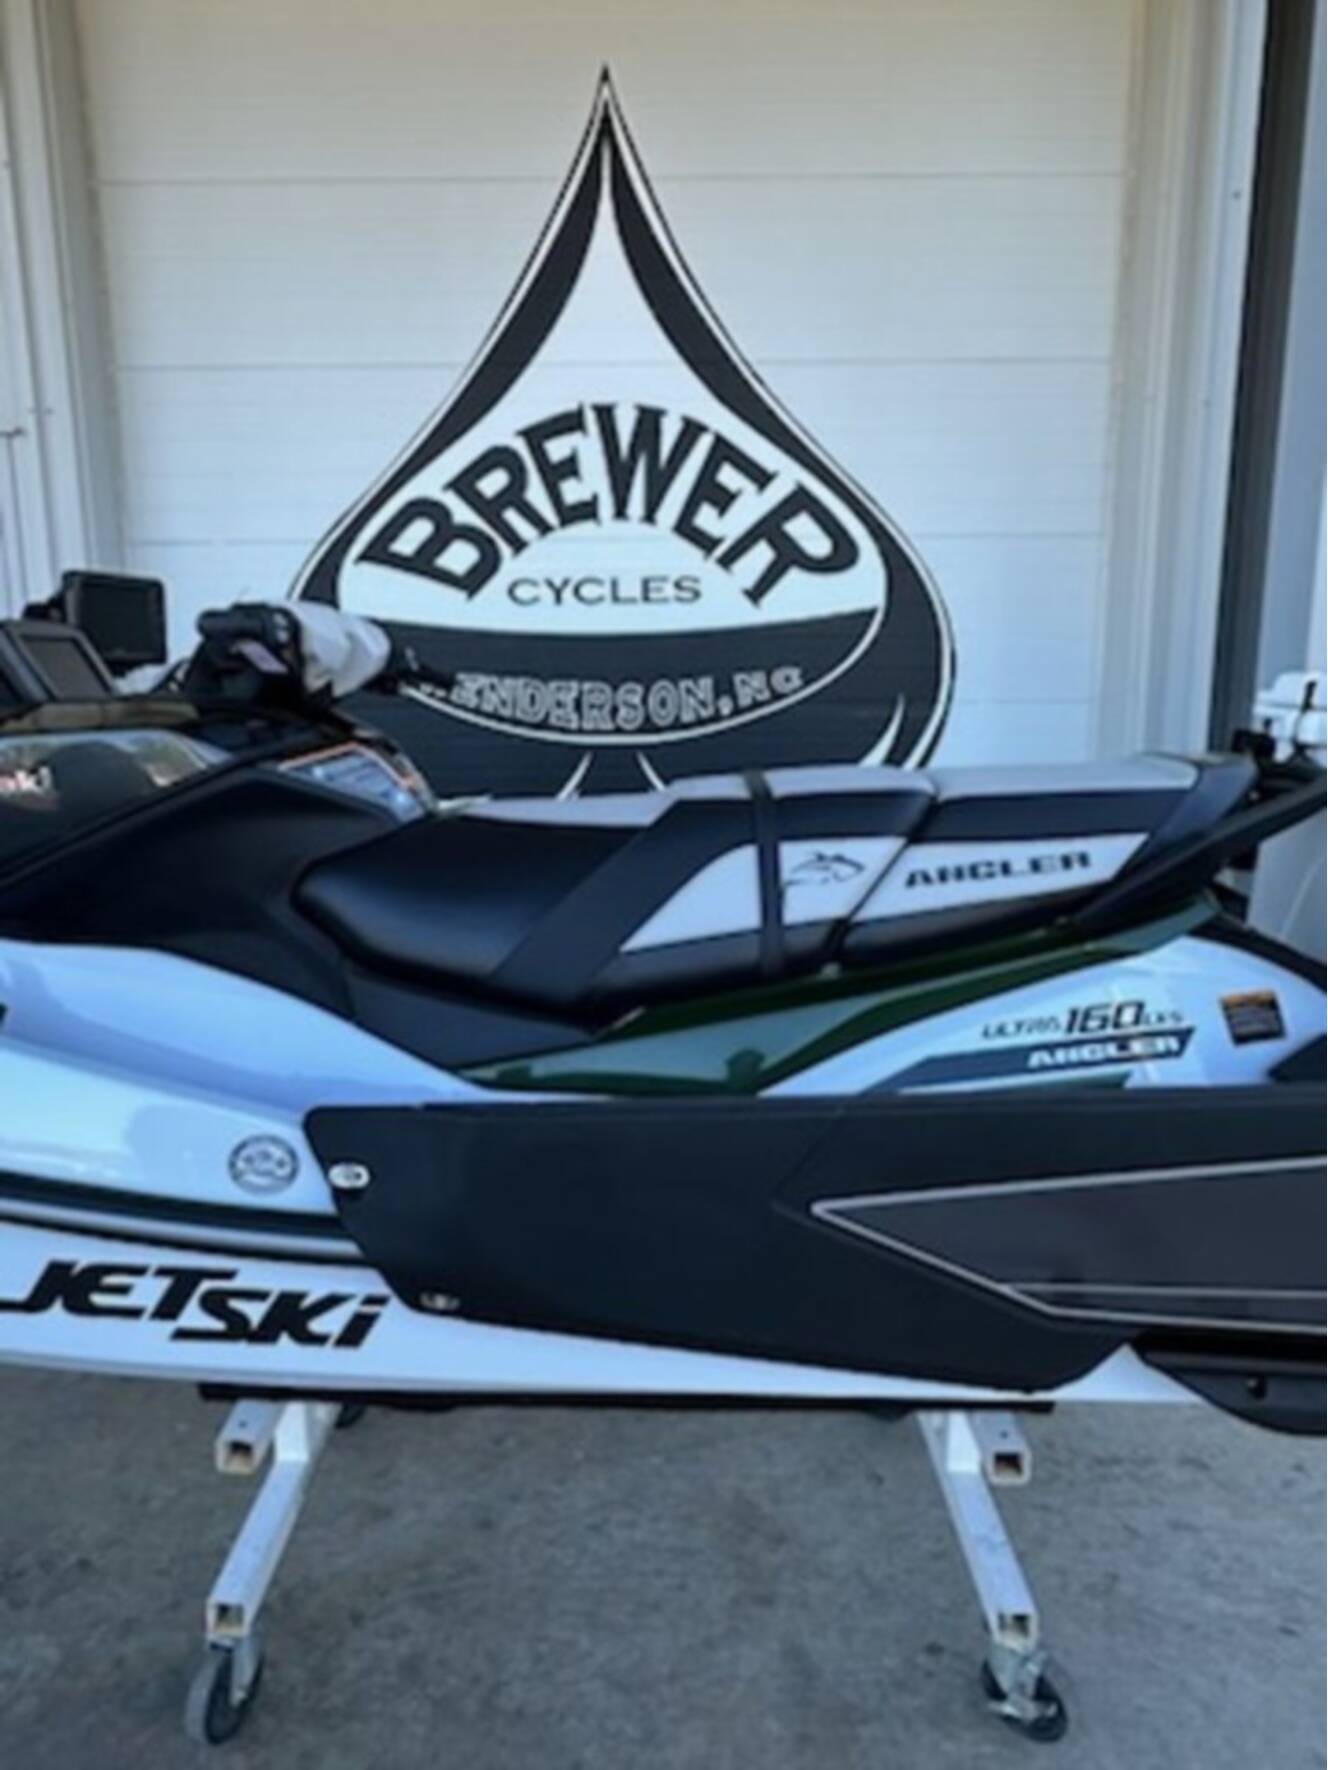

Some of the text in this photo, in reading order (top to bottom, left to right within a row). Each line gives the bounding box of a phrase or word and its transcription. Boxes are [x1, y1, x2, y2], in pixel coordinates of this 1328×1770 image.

[354, 402, 860, 608] BREWER
[506, 575, 702, 605] CYCLES
[905, 852, 1091, 888] ANGLER
[1027, 1035, 1181, 1069] ANGLER
